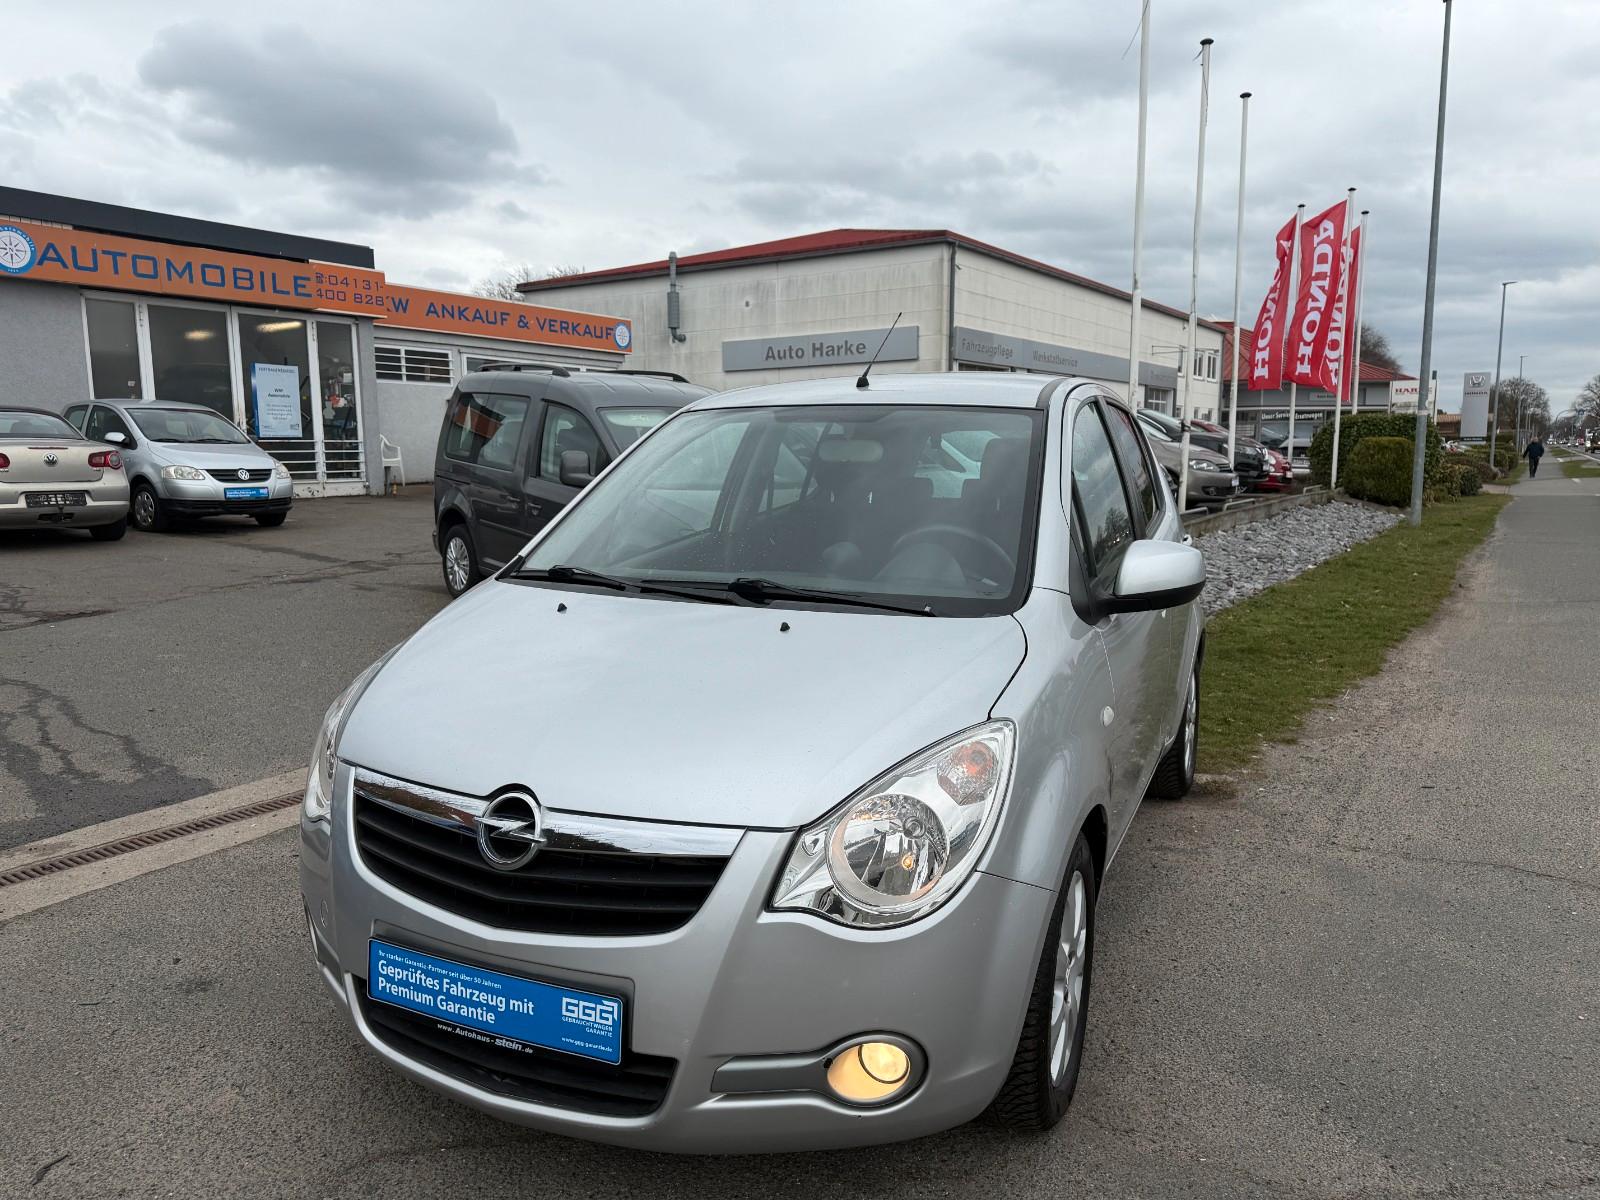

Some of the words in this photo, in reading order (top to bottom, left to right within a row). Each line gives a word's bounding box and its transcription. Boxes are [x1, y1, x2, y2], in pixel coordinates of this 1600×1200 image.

[37, 242, 313, 298] AUTOMOBILE
[1296, 219, 1335, 377] HONDA
[425, 302, 511, 327] ANKAUF
[517, 313, 530, 330] &
[535, 315, 615, 340] VERKAUF
[764, 345, 806, 362] Auto
[810, 339, 867, 359] Harke
[378, 959, 440, 990] Geprüftes
[442, 978, 506, 1012] Fahrzeug
[509, 998, 535, 1016] mit
[448, 970, 459, 979] seit
[482, 979, 502, 990] Jahren
[378, 976, 434, 1007] Premium
[436, 995, 496, 1024] Garantie
[562, 997, 615, 1026] GGG
[561, 1015, 613, 1032] GEBRAUCHTWAGEN
[585, 1027, 613, 1038] GARANTIE
